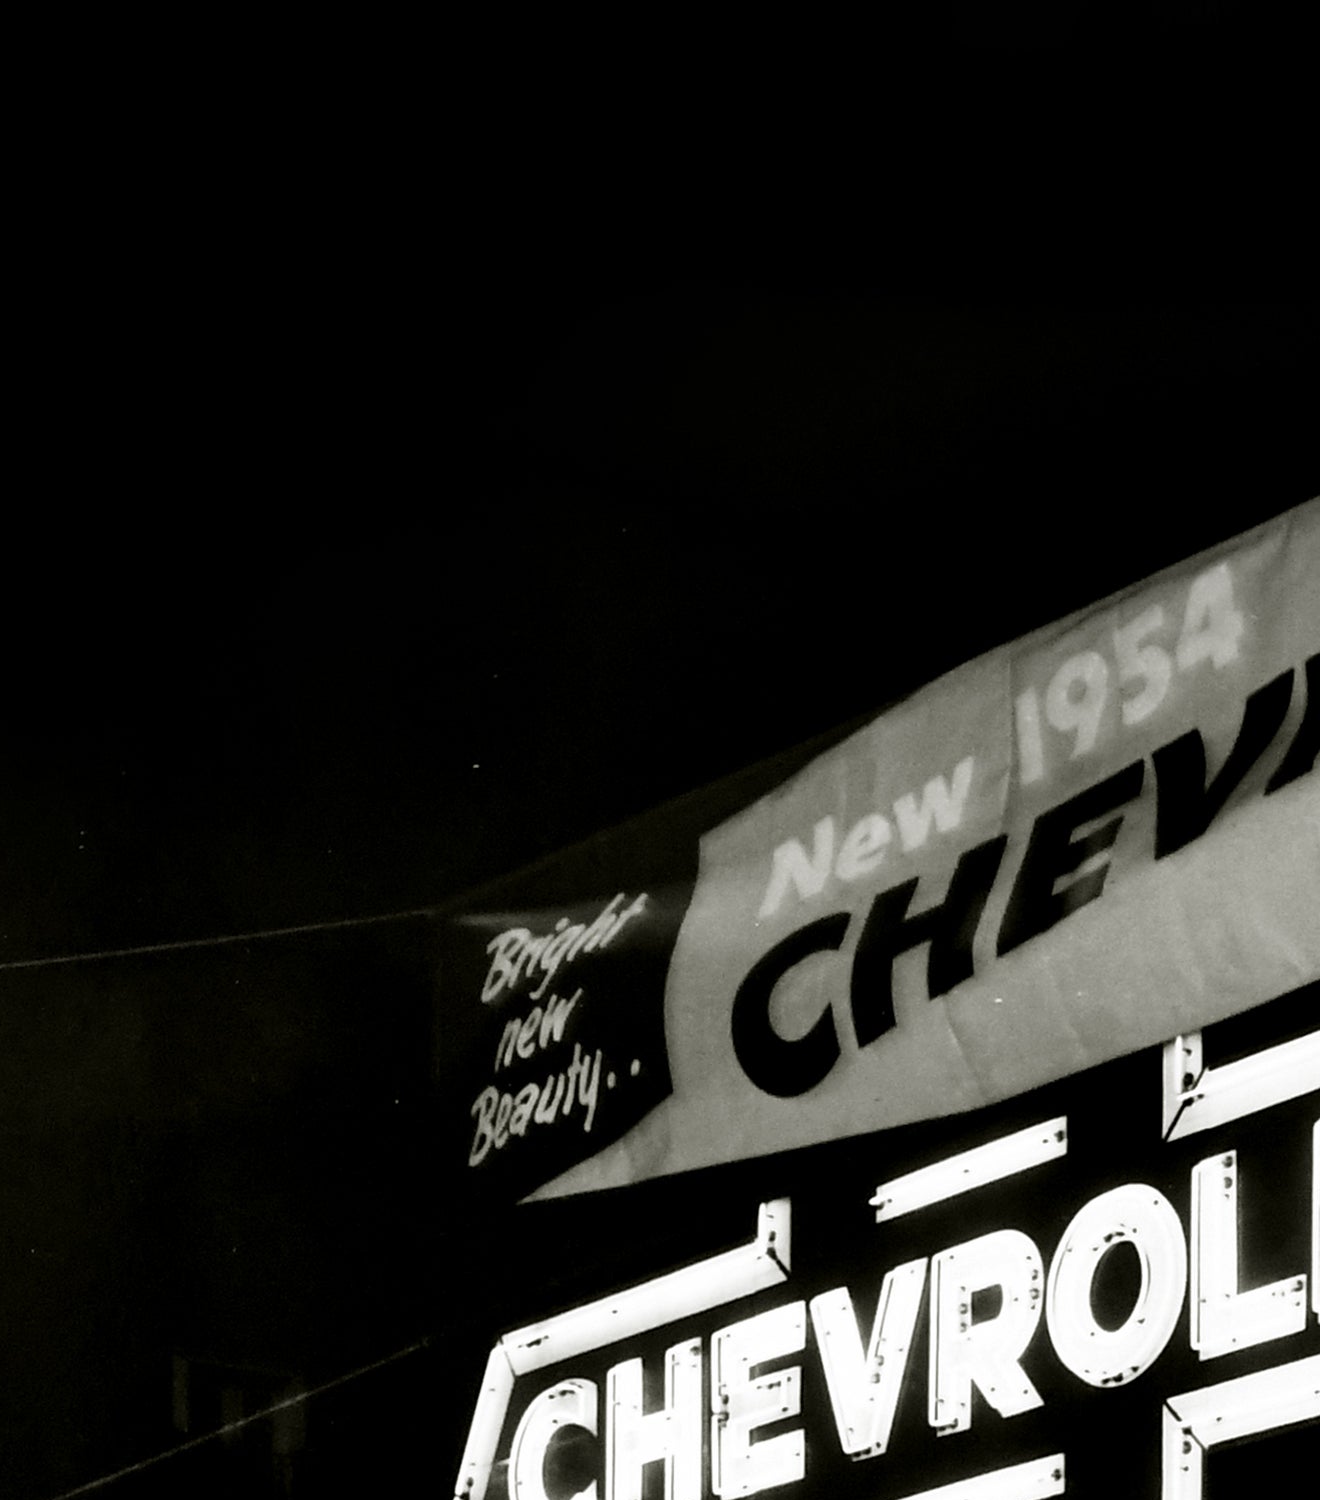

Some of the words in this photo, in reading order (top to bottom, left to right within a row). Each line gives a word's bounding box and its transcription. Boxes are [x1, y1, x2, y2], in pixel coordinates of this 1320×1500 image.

[757, 755, 974, 919] New
[1015, 560, 1249, 787] 1954
[481, 892, 649, 1003] Bright
[495, 988, 583, 1071] new
